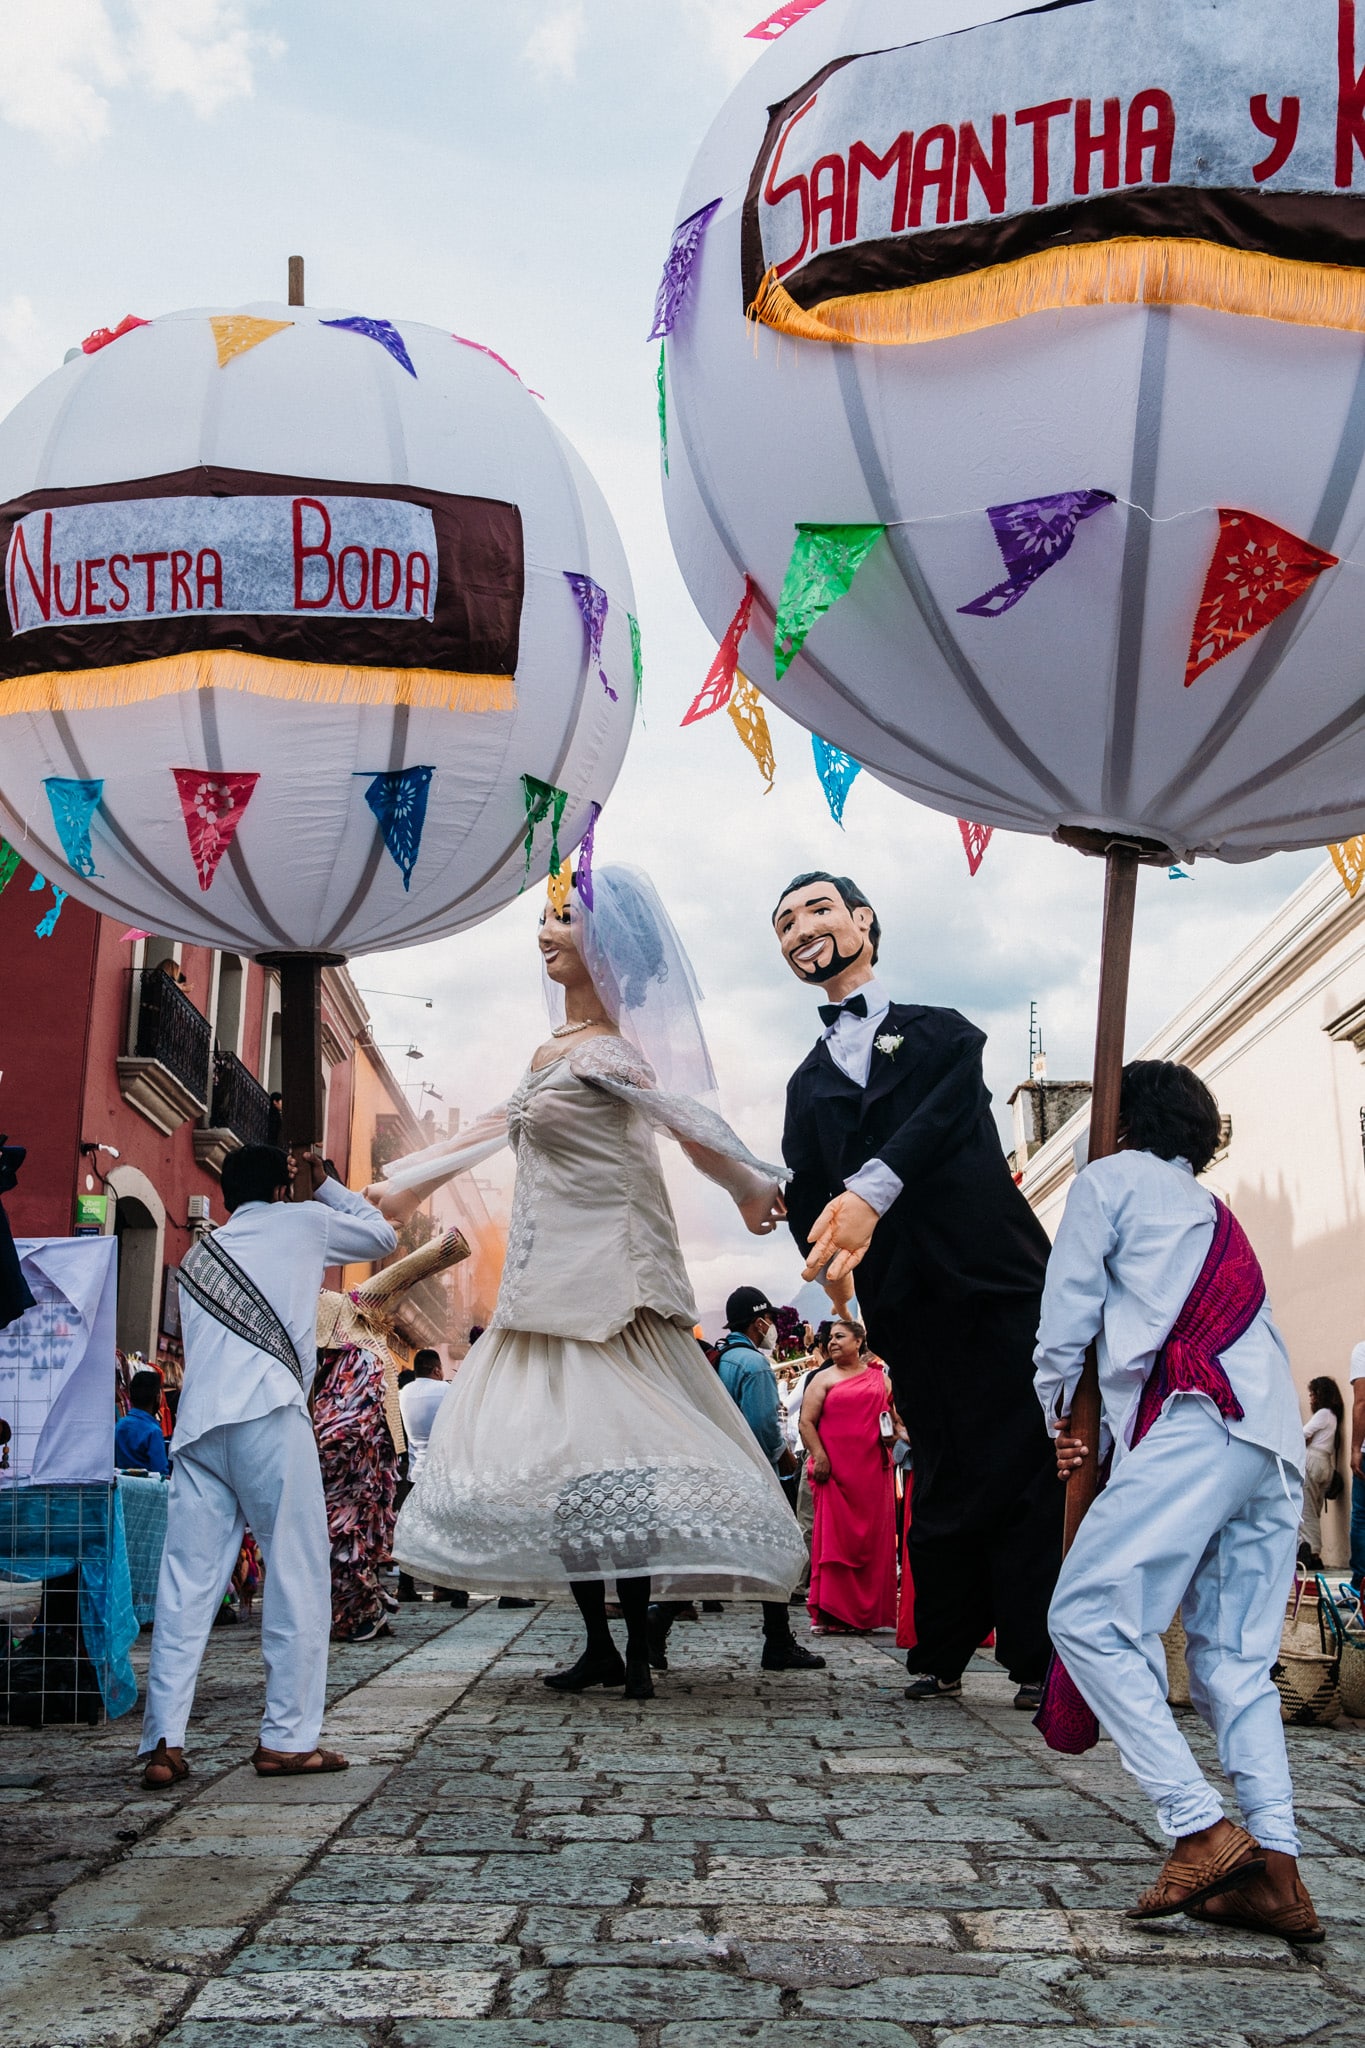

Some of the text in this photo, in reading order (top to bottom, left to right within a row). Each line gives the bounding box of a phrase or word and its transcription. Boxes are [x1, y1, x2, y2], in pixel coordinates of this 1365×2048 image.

[764, 88, 1175, 279] SAMANTHA
[9, 497, 432, 631] NUESTRA BODA
